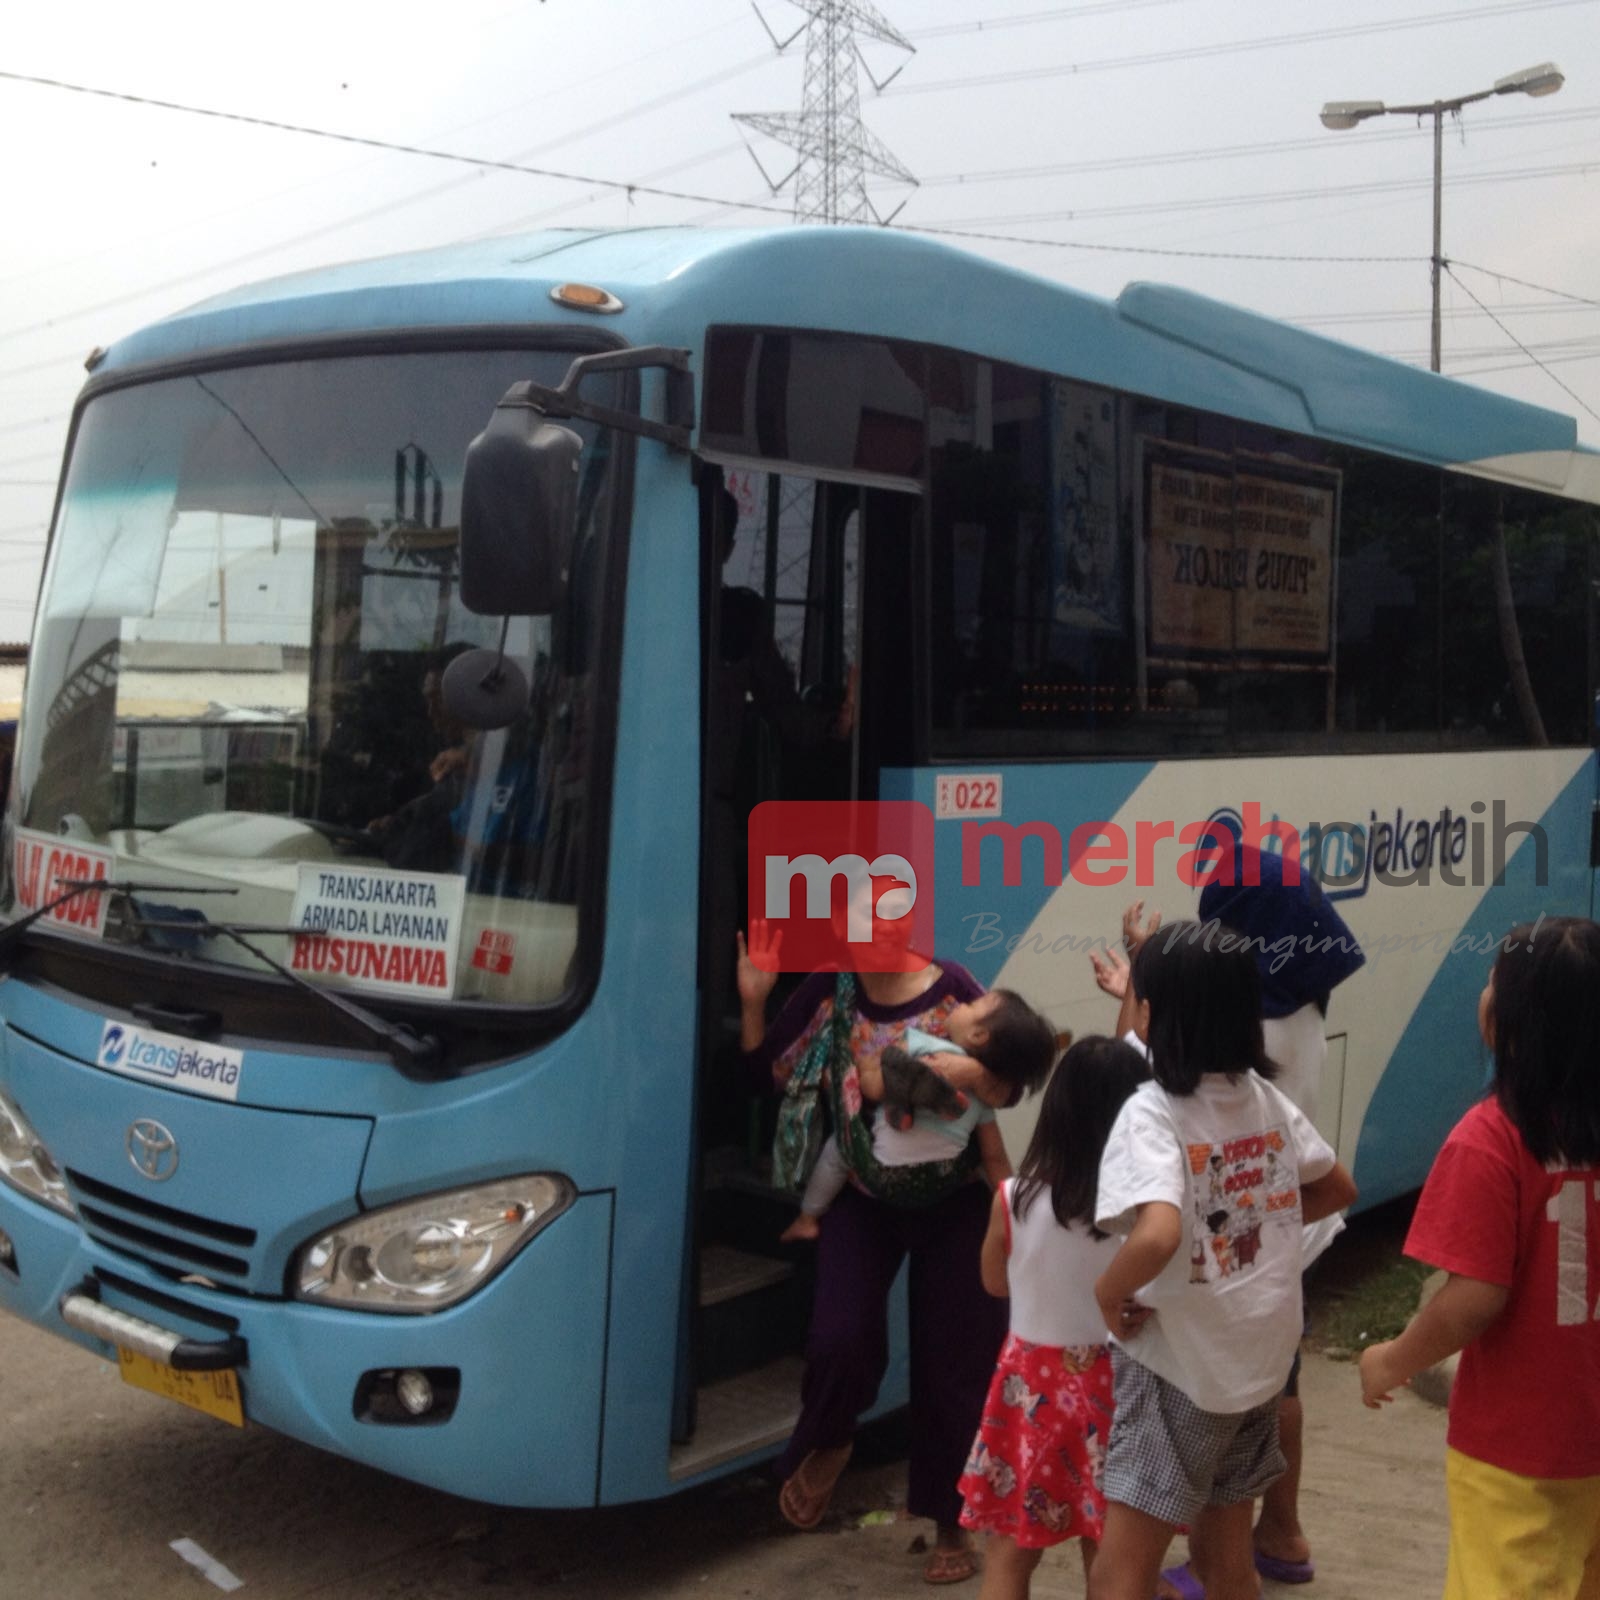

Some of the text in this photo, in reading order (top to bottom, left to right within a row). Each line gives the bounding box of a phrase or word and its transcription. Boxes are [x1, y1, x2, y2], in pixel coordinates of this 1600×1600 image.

[955, 781, 998, 810] 022
[318, 873, 438, 908] TRANSJAKARTA
[301, 904, 449, 943] ARMADA LAYANAN
[292, 933, 449, 989] RUSUNAWA
[126, 1033, 239, 1086] transjakarta
[1545, 1179, 1600, 1327] 1
